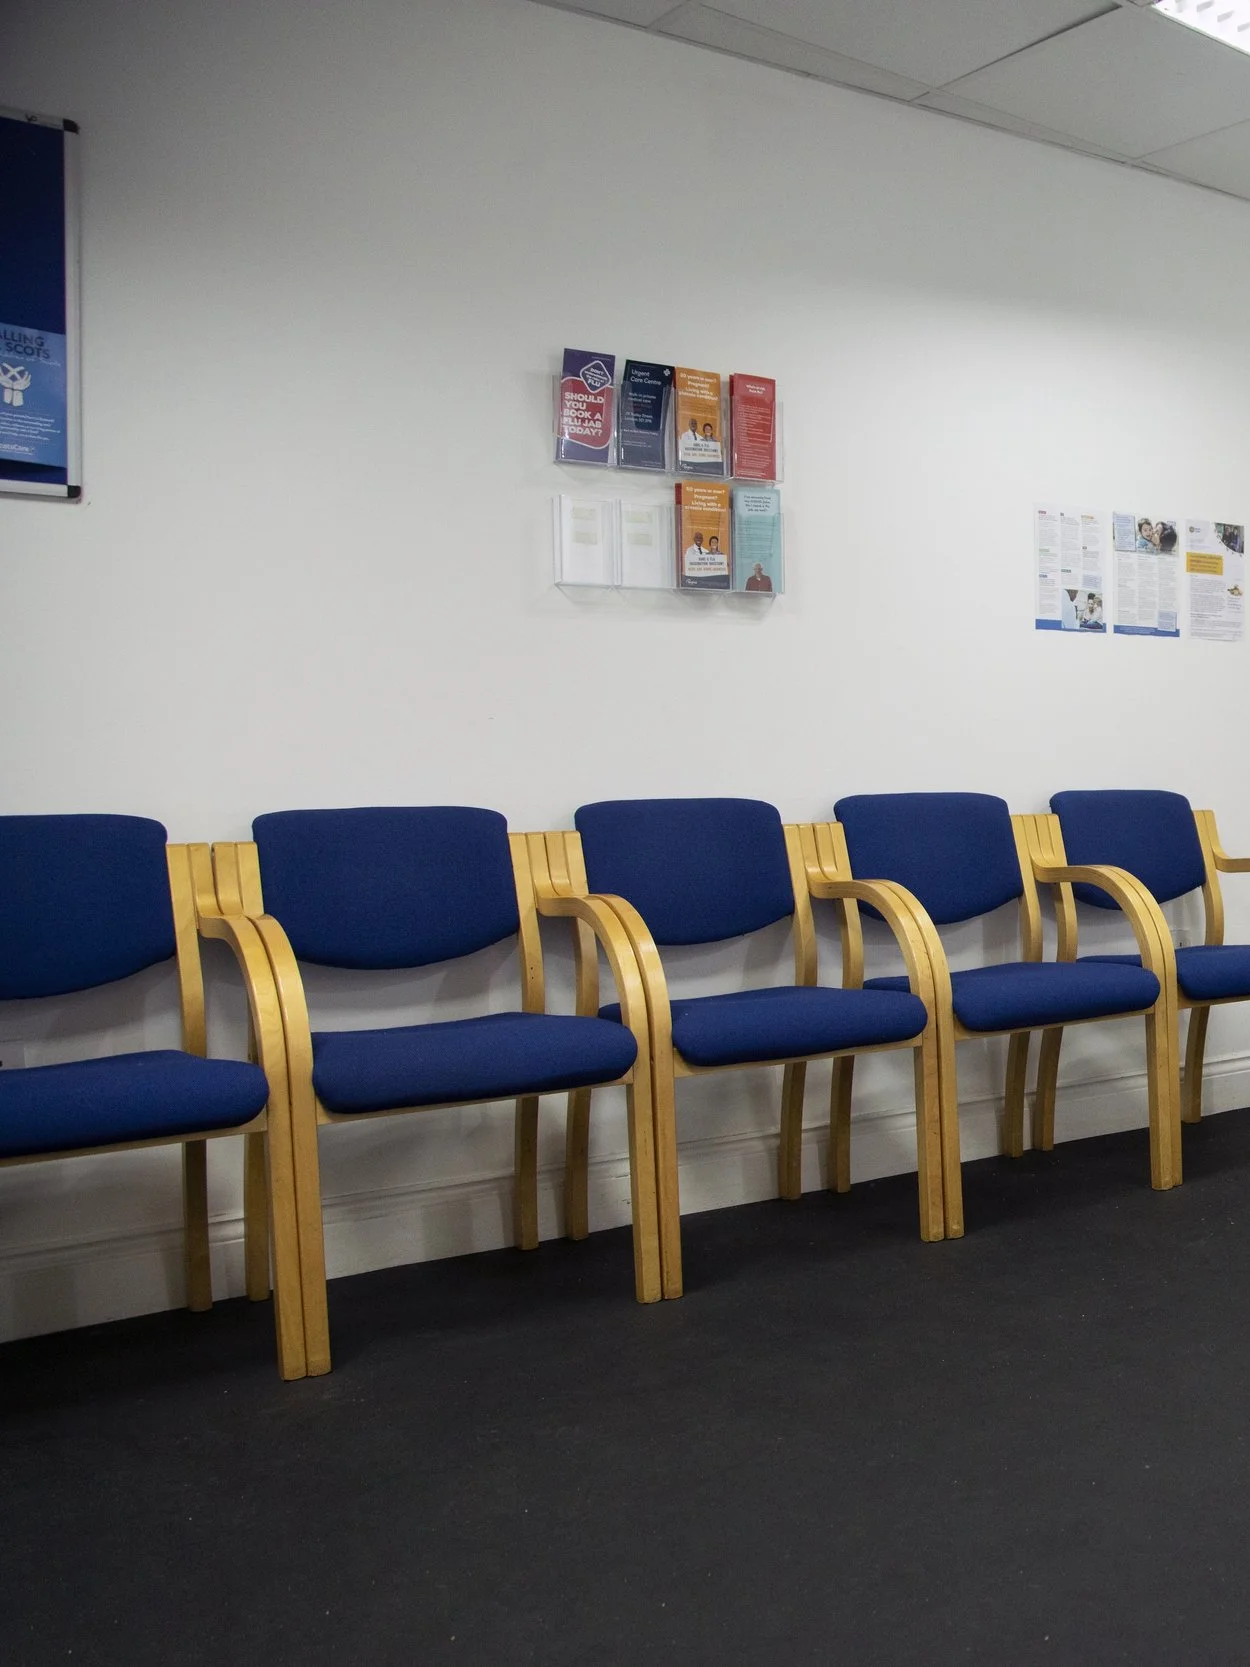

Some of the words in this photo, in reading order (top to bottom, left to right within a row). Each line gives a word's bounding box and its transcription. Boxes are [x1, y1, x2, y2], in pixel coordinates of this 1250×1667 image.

[0, 329, 45, 347] LLING
[6, 342, 50, 359] SCOTS
[631, 369, 650, 377] Urgent
[587, 379, 601, 387] FLU
[643, 378, 661, 386] Centre
[564, 391, 604, 404] SHOULD
[565, 400, 587, 410] YOU
[563, 408, 592, 419] BOOK
[594, 412, 602, 421] A
[562, 416, 581, 426] FLU
[582, 419, 602, 428] JAB
[562, 425, 603, 437] TODAY?
